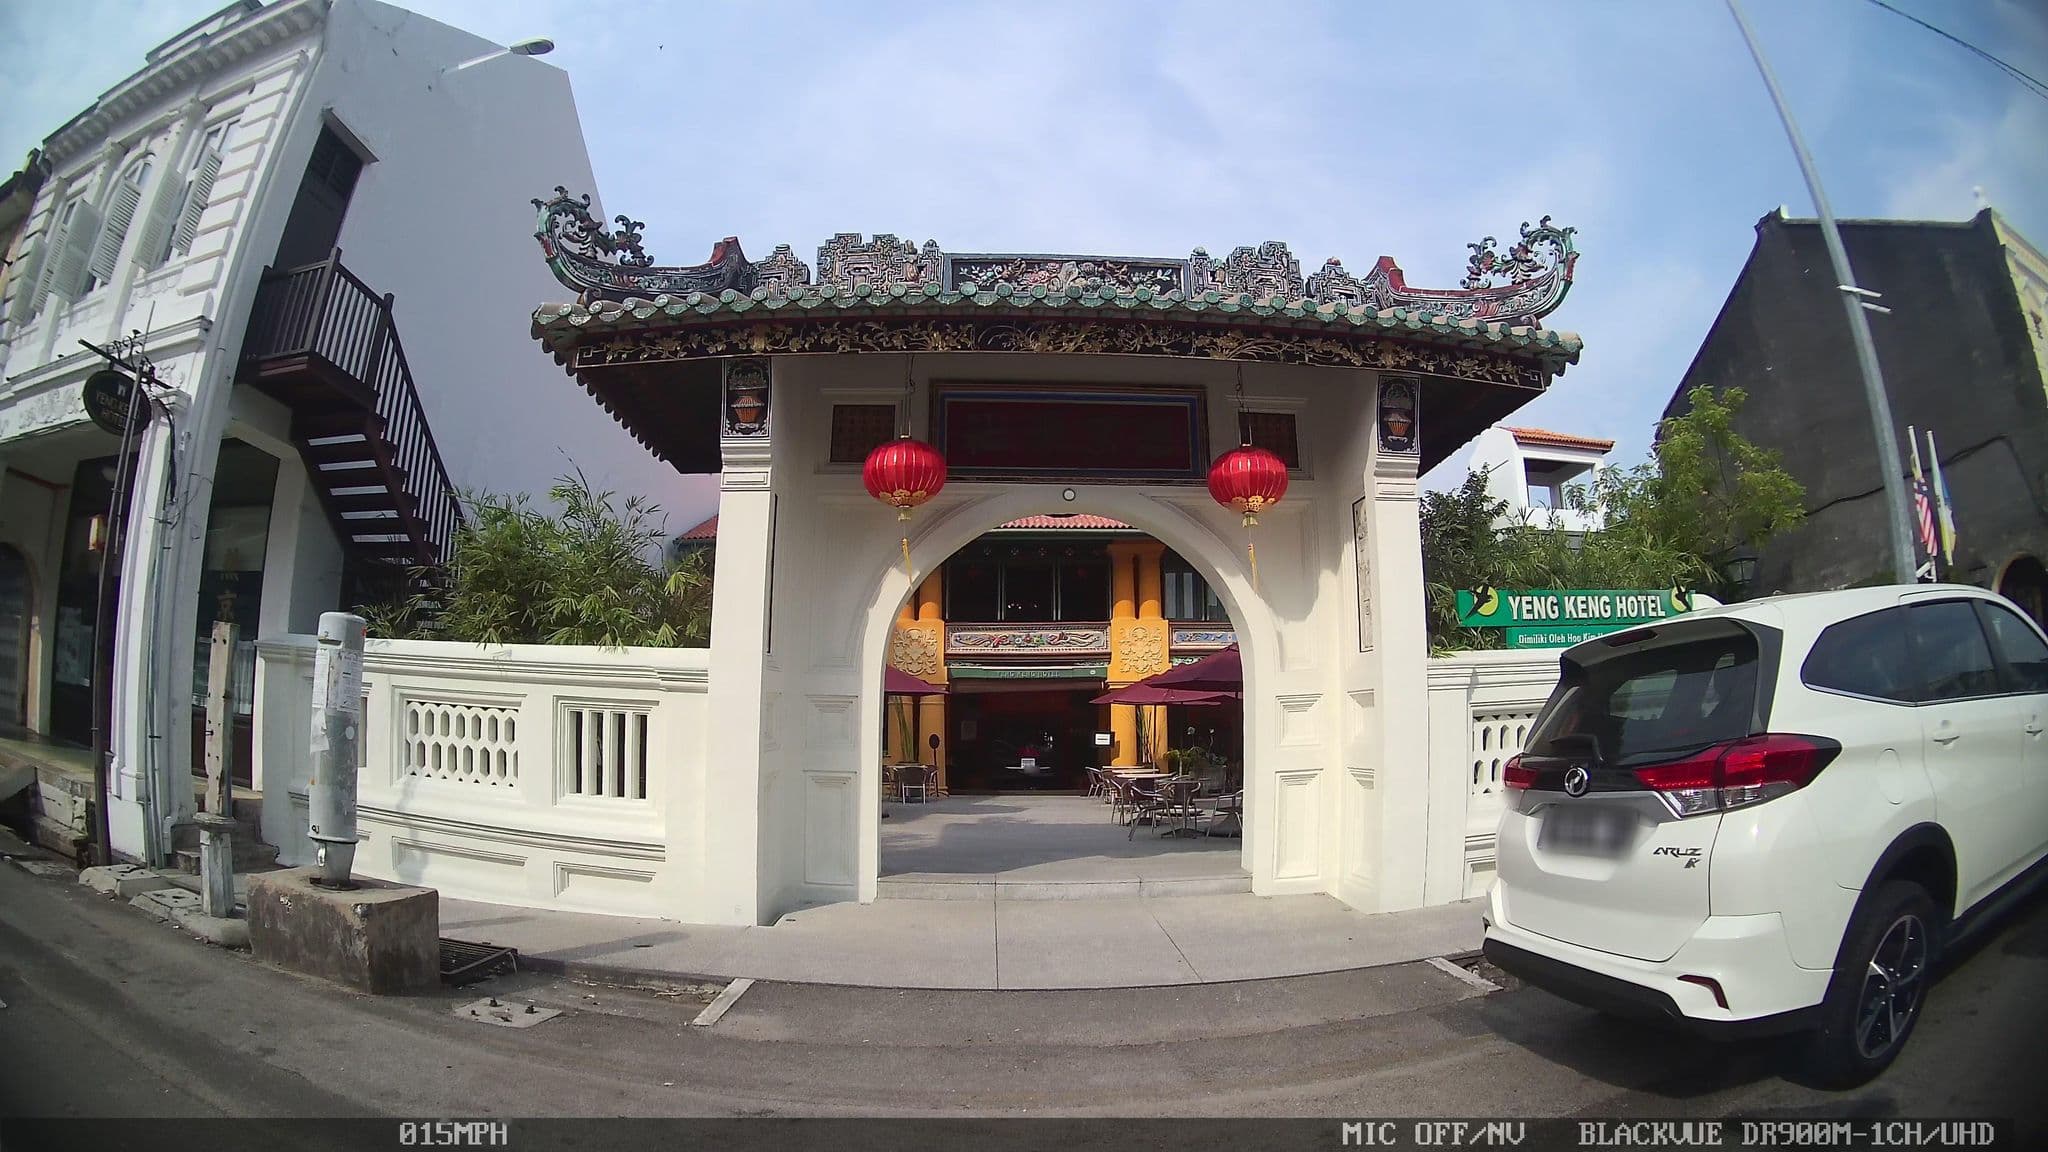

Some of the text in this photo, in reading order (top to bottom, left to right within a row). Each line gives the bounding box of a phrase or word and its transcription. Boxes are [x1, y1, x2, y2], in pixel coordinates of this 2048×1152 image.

[1508, 594, 1666, 620] YENG KENG HOTEL
[1518, 634, 1547, 644] Dimiliki
[1549, 633, 1566, 644] Oleh
[1653, 847, 1702, 858] ARUZ
